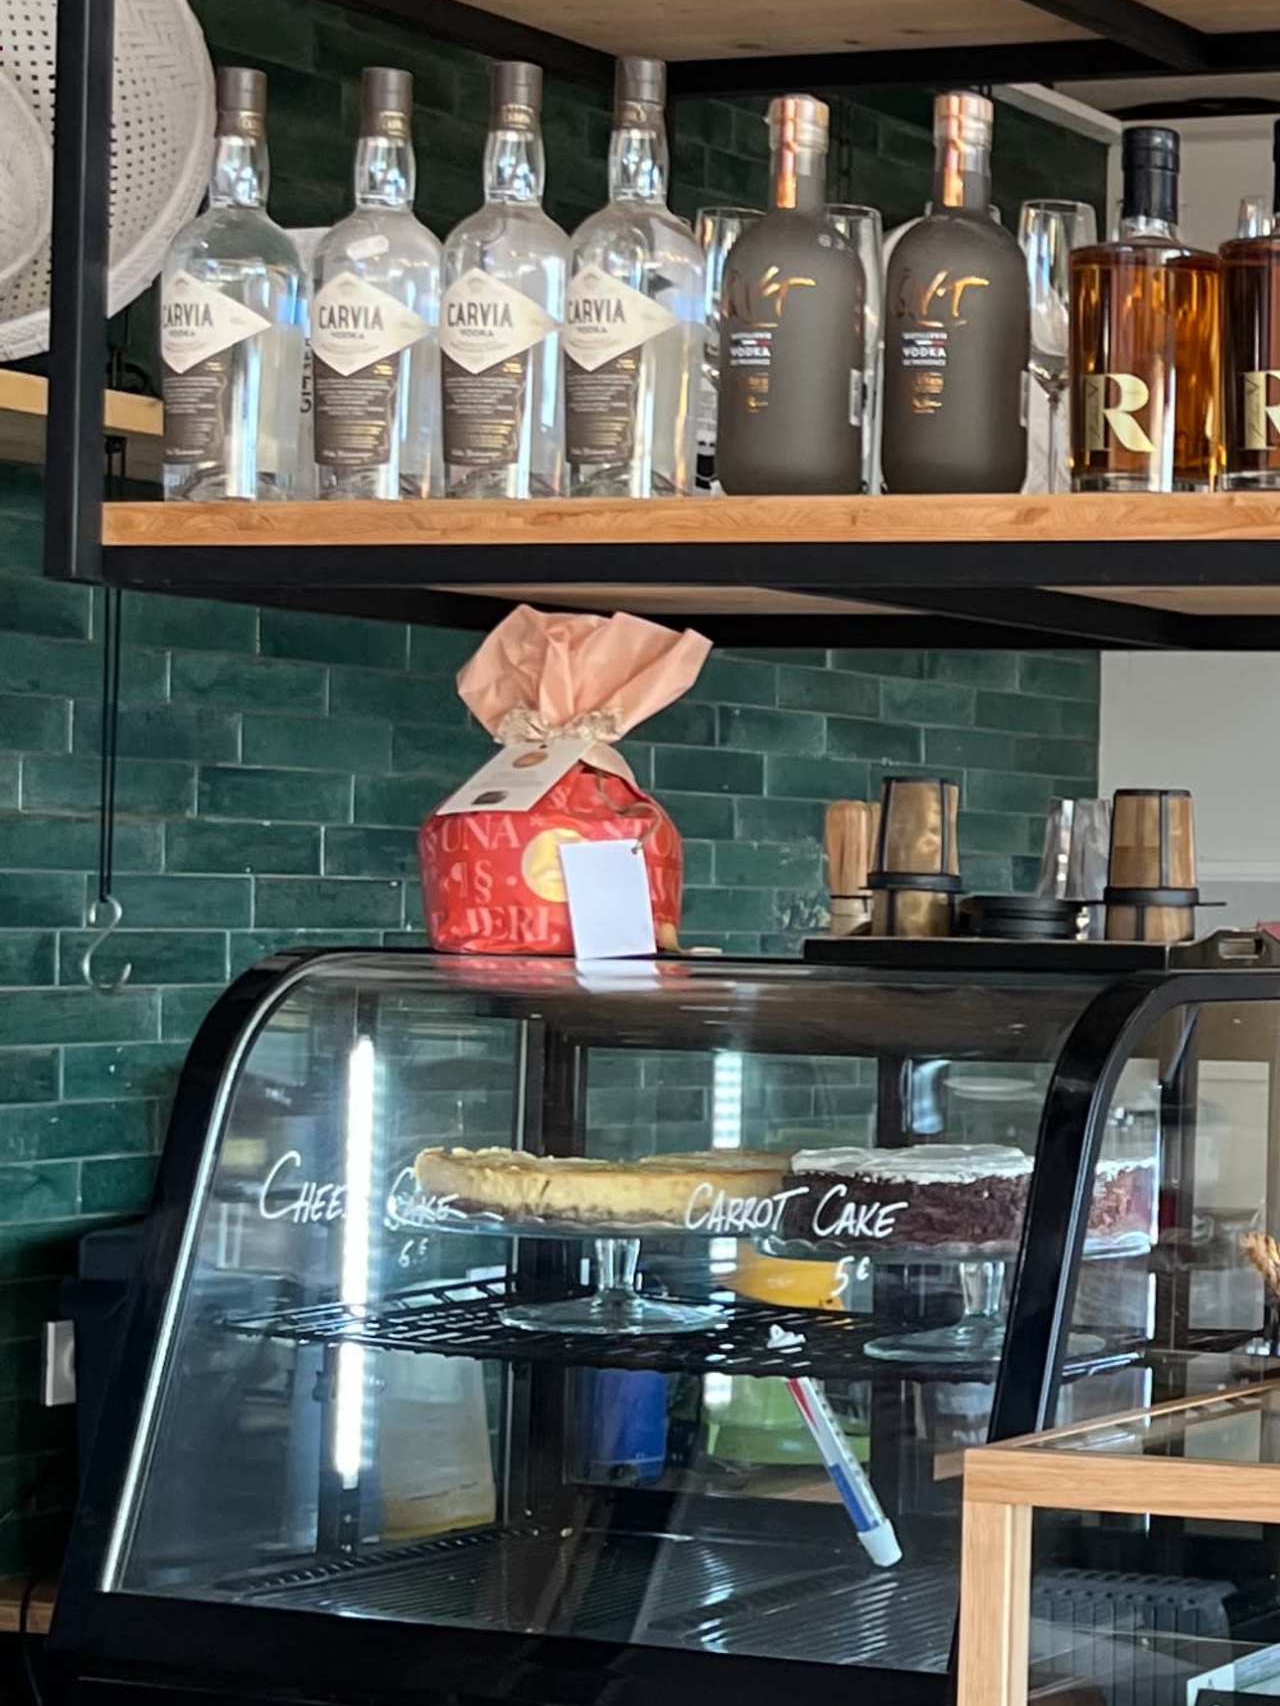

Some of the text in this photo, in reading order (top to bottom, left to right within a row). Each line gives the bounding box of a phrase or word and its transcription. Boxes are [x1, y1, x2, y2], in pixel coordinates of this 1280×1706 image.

[164, 303, 214, 329] CARVIA
[319, 304, 385, 331] CARVIA
[447, 301, 514, 329] CARVIA
[567, 297, 627, 325] CARVIA
[902, 346, 947, 358] VODKA
[1085, 373, 1156, 453] R
[684, 1182, 910, 1239] CARROT CAKE
